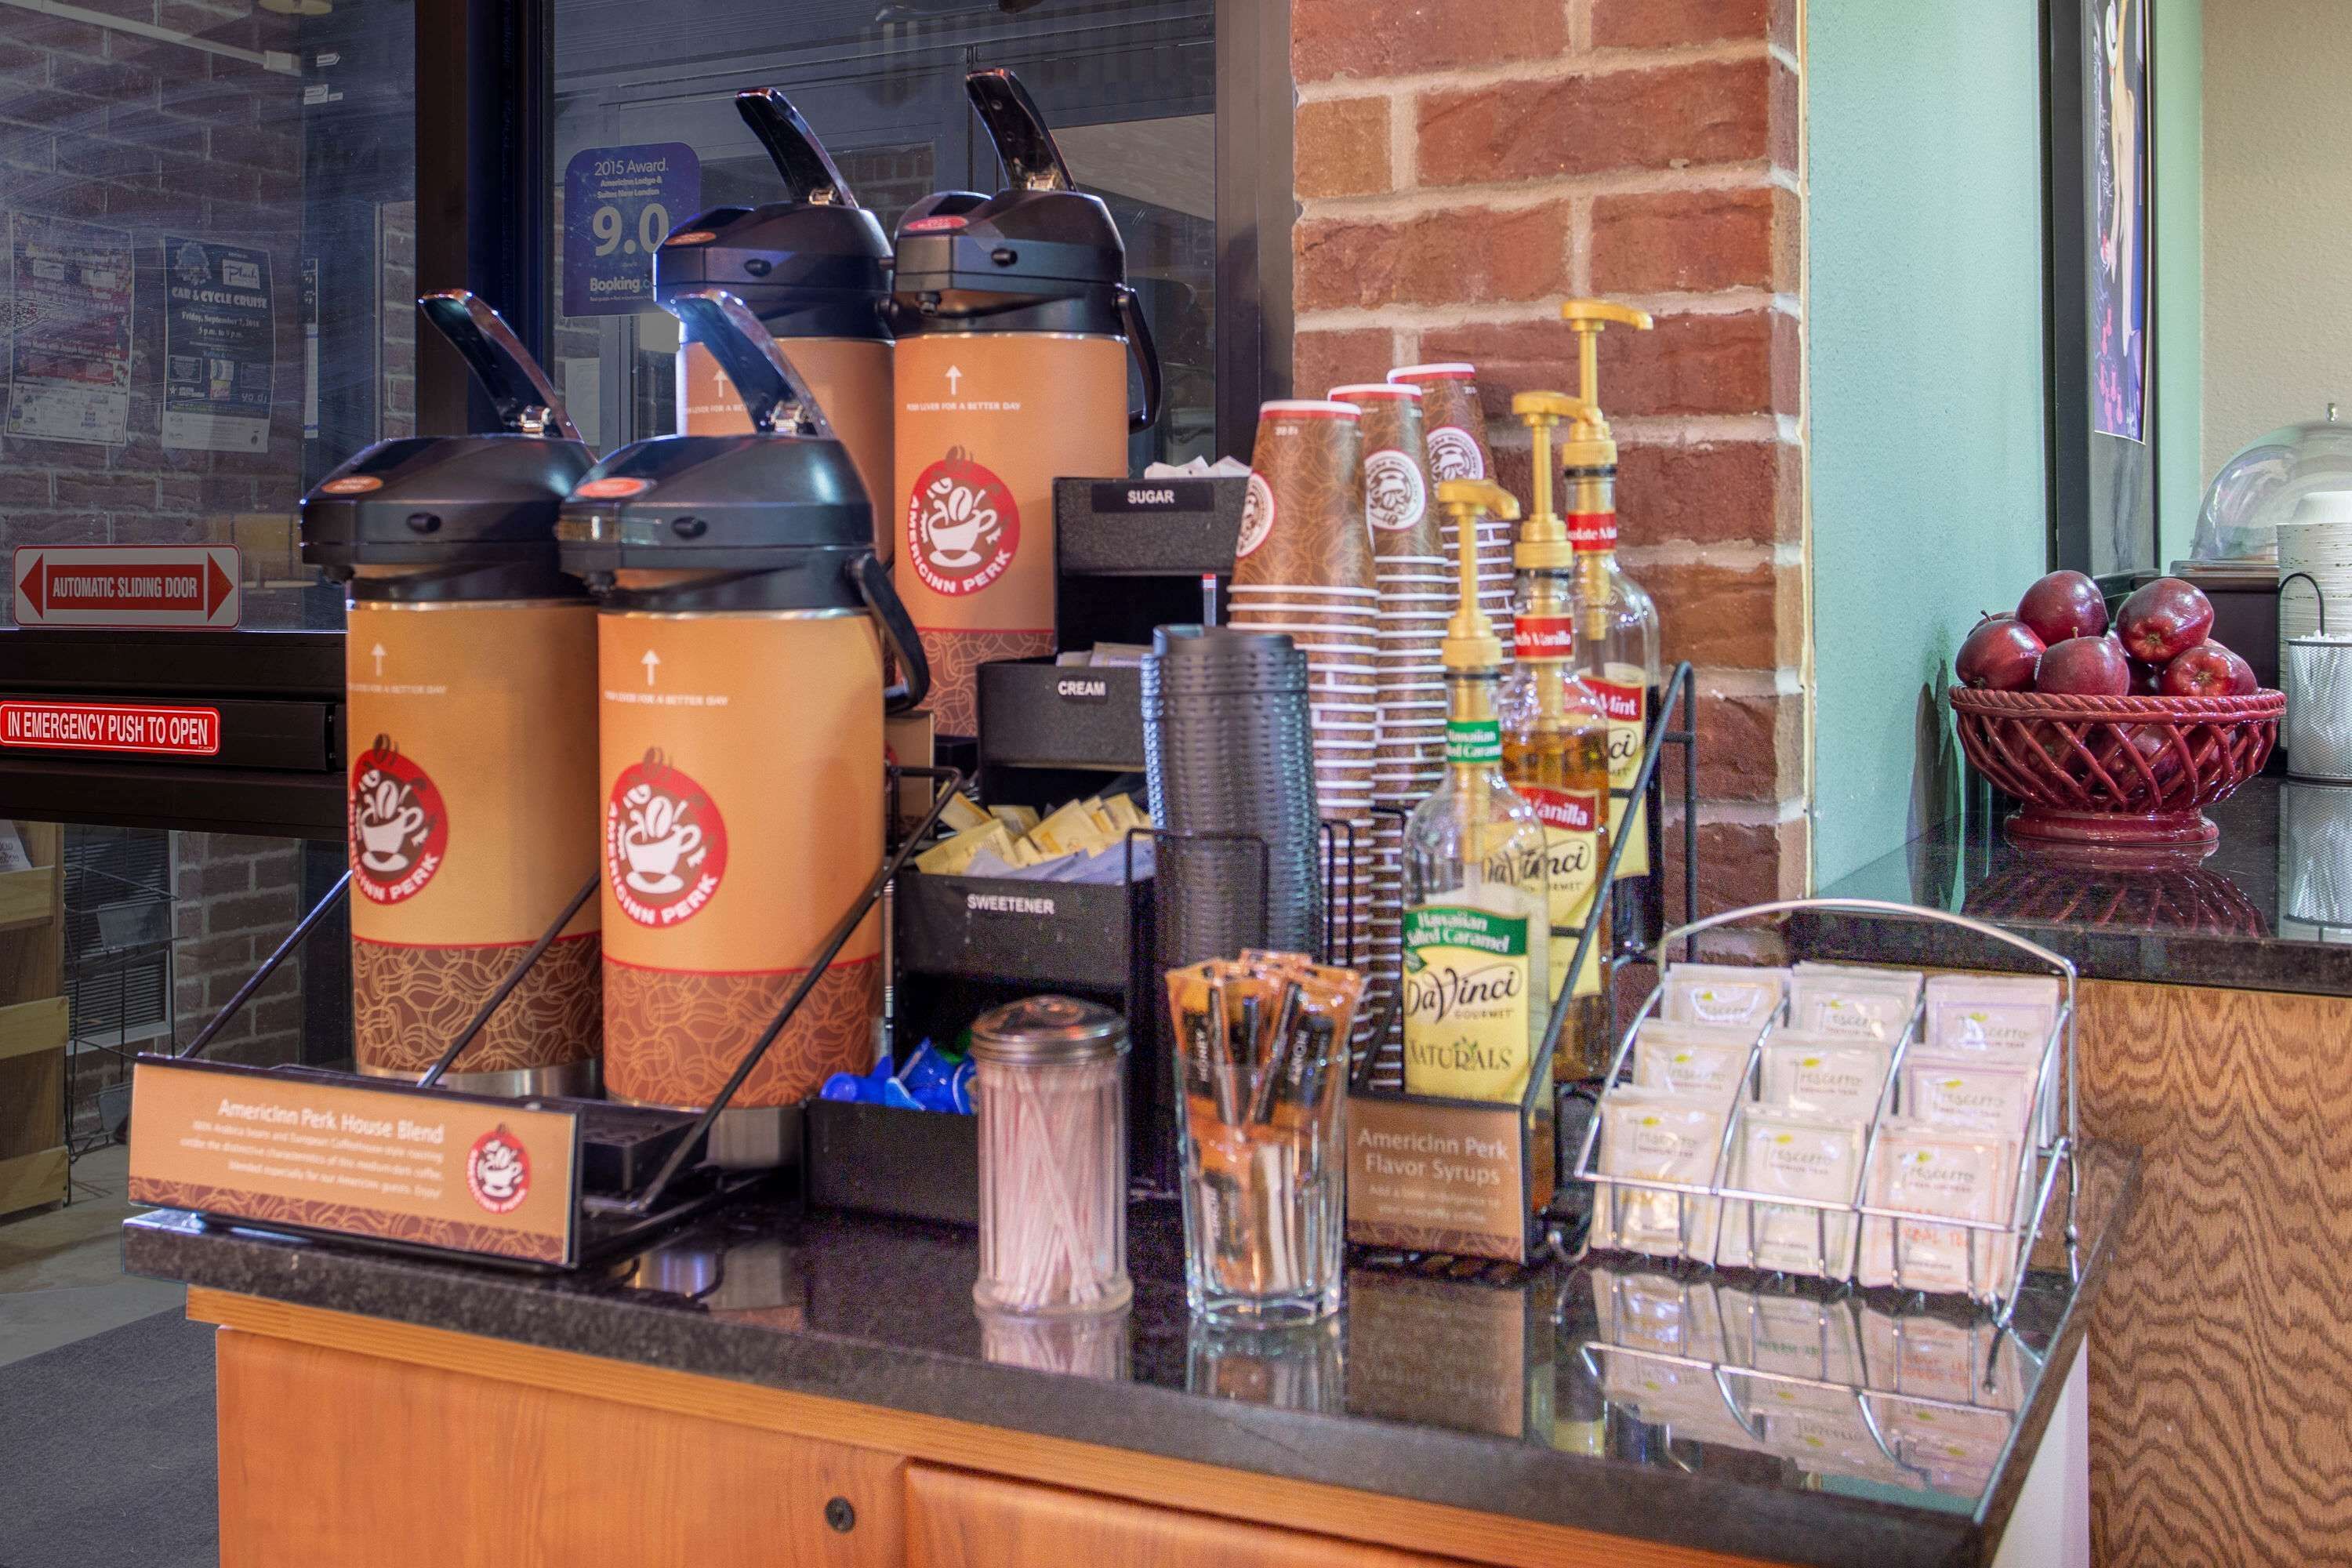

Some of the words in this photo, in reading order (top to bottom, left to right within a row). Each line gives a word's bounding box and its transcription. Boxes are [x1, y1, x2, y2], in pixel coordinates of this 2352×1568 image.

[593, 160, 625, 176] 2015
[634, 188, 659, 197] London
[593, 202, 669, 257] 9.0
[172, 287, 190, 299] CAR
[191, 289, 199, 301] &
[201, 291, 232, 304] CYCLE
[234, 295, 267, 309] CRUISE
[967, 401, 1000, 410] BETTER
[1003, 401, 1022, 410] DAY
[1127, 489, 1174, 504] SUGAR
[909, 495, 956, 593] AMERICINN
[961, 548, 1011, 593] PERK
[52, 576, 114, 598] AUTOMATIC
[117, 576, 162, 598] SLIDING
[165, 576, 198, 597] DOOR
[666, 695, 703, 706] BETTER
[1058, 681, 1105, 696] CREAM
[8, 711, 20, 737] IN
[24, 711, 104, 741] EMERGENCY
[107, 714, 144, 743] PUSH
[147, 717, 166, 744] TO
[169, 717, 208, 746] OPEN
[388, 852, 439, 899] PERK
[660, 871, 718, 924] PERK
[967, 893, 1054, 916] SWEETENER
[1417, 912, 1488, 932] Hawaiian
[1443, 928, 1510, 953] Caramel
[1404, 964, 1523, 1024] DaVinci
[300, 1107, 339, 1131] Perk
[340, 1112, 395, 1138] House
[396, 1119, 446, 1145] Blend
[1465, 1135, 1510, 1162] Perk
[1366, 1152, 1425, 1178] Flavor
[1432, 1159, 1501, 1189] Syrups
